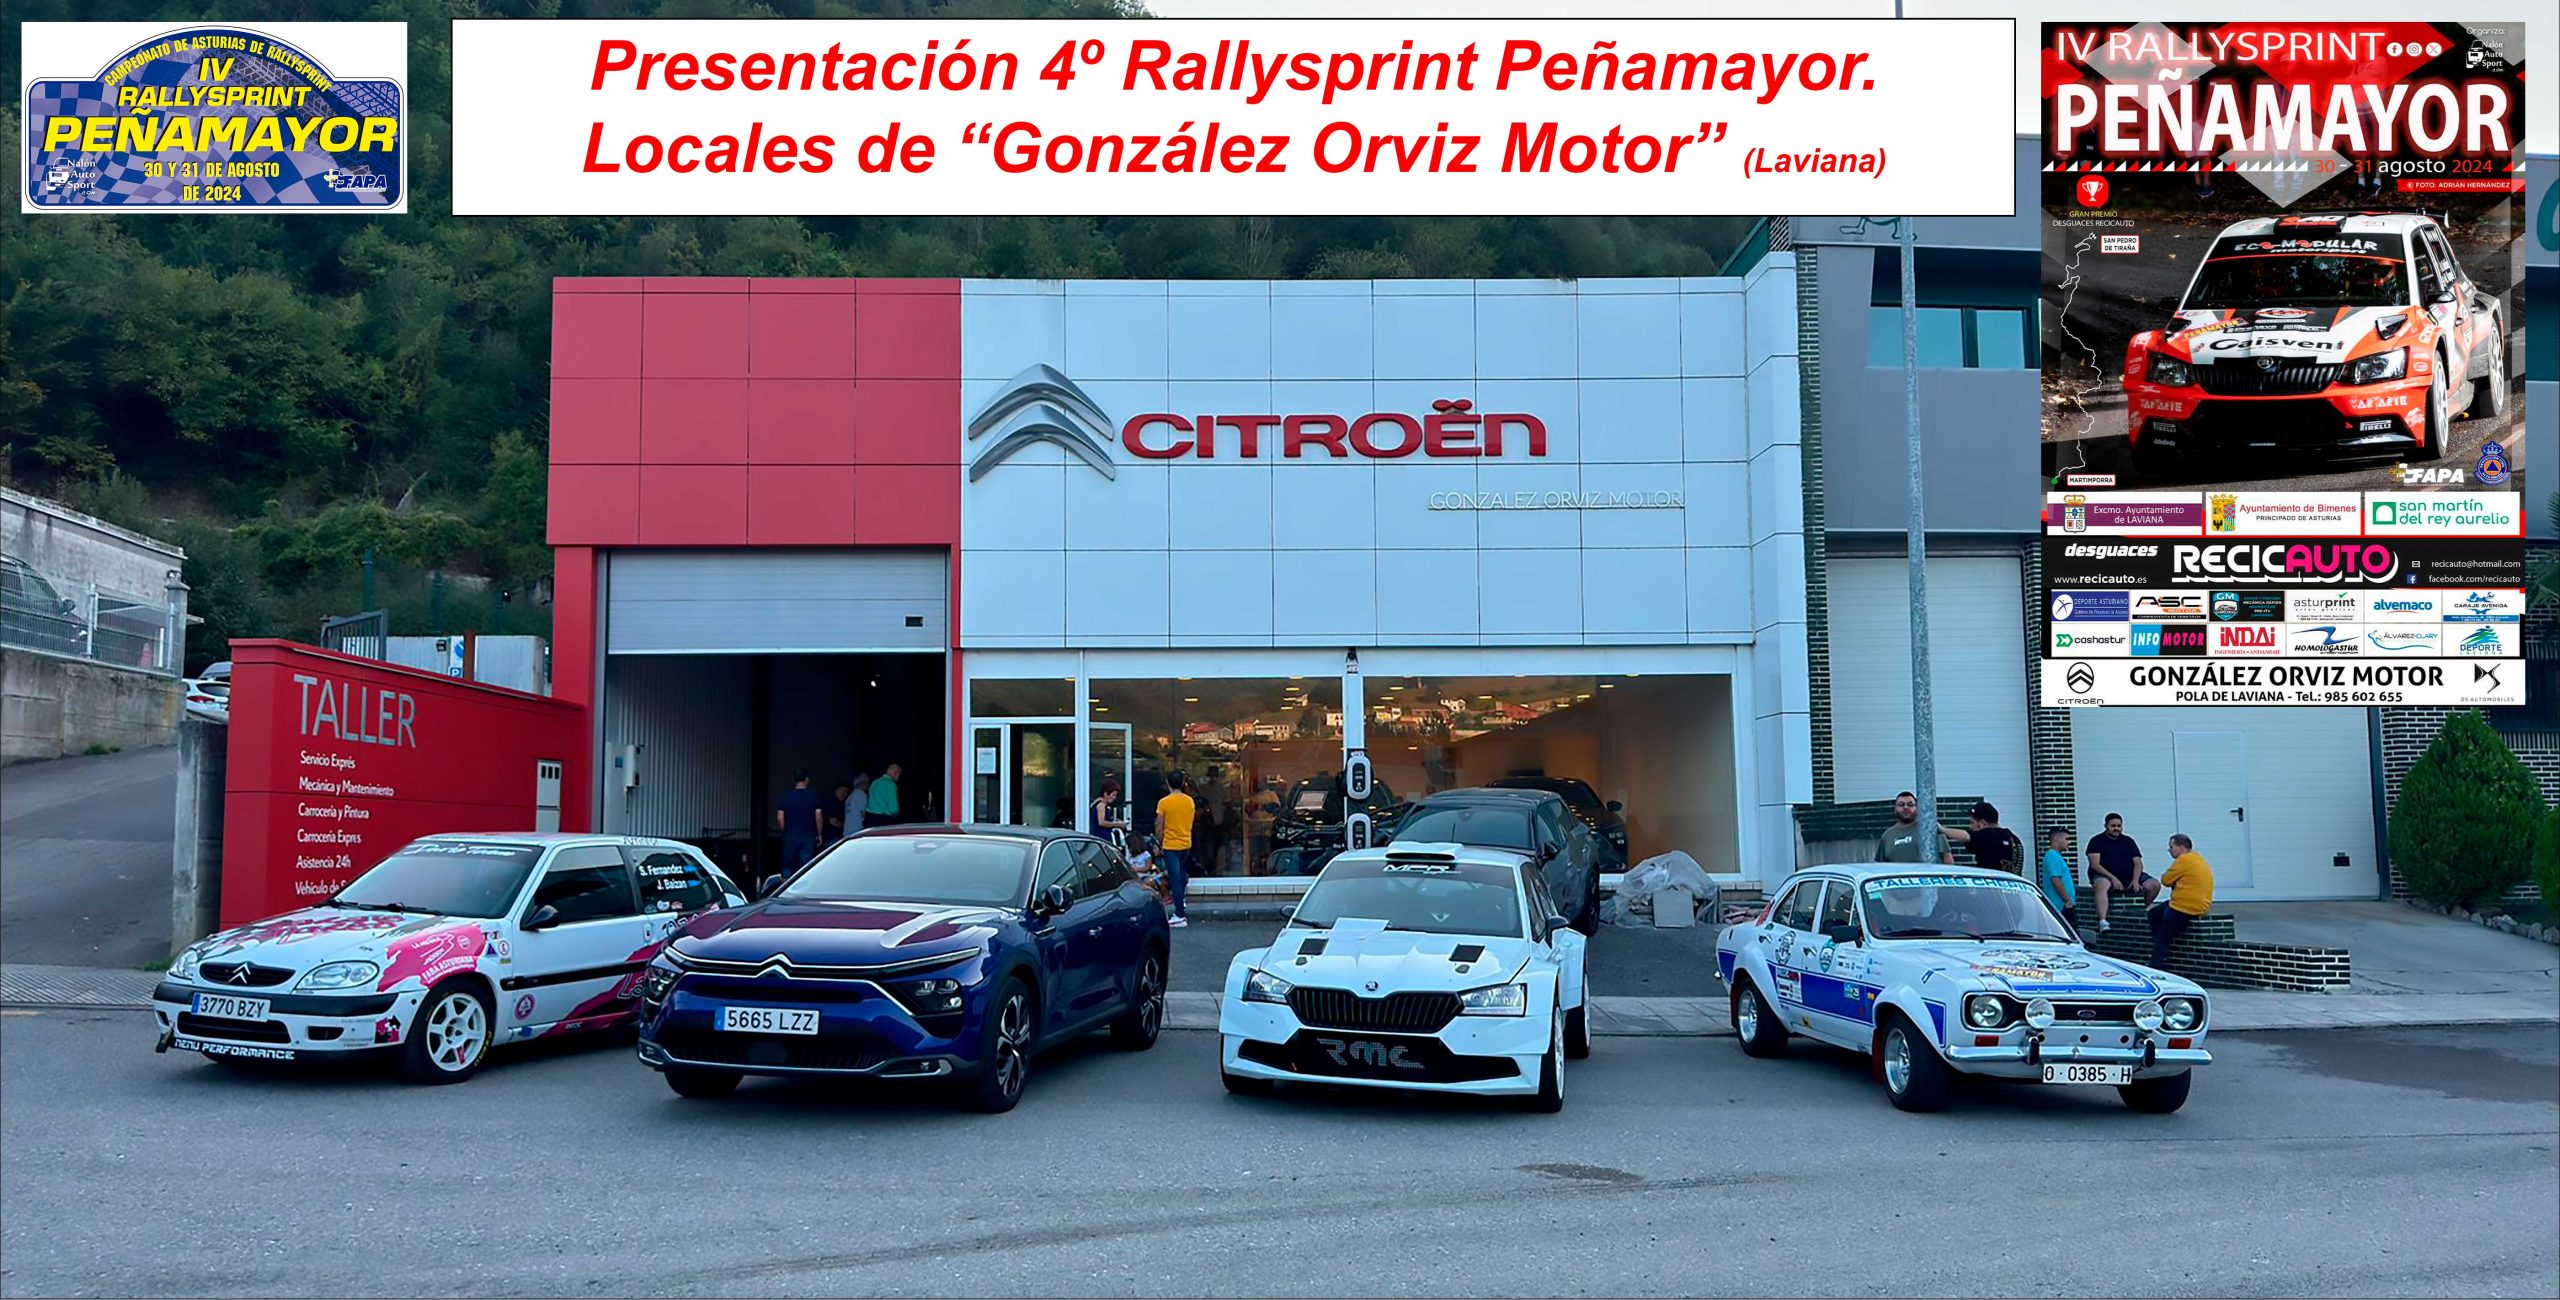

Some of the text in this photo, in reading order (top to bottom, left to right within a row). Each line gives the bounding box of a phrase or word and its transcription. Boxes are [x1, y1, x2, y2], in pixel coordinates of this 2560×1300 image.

[1122, 399, 1547, 458] CITROËN
[1544, 491, 1602, 509] ORVIZ
[1608, 490, 1685, 508] MOTOR
[293, 673, 417, 749] TALLER
[300, 750, 330, 766] Servicio
[299, 776, 395, 797] Mecánica y Mantenimiento
[337, 809, 342, 821] y
[343, 805, 370, 819] Pintura
[295, 854, 352, 869] Asistencia 24h
[639, 866, 648, 876] S.
[1874, 876, 1964, 889] TALLERES
[200, 997, 265, 1019] 3770 BZY
[727, 1007, 815, 1032] 5665 LZZ
[202, 1043, 295, 1060] PERFORMANCE
[2068, 1066, 2107, 1082] 0385
[2120, 1067, 2131, 1082] H
